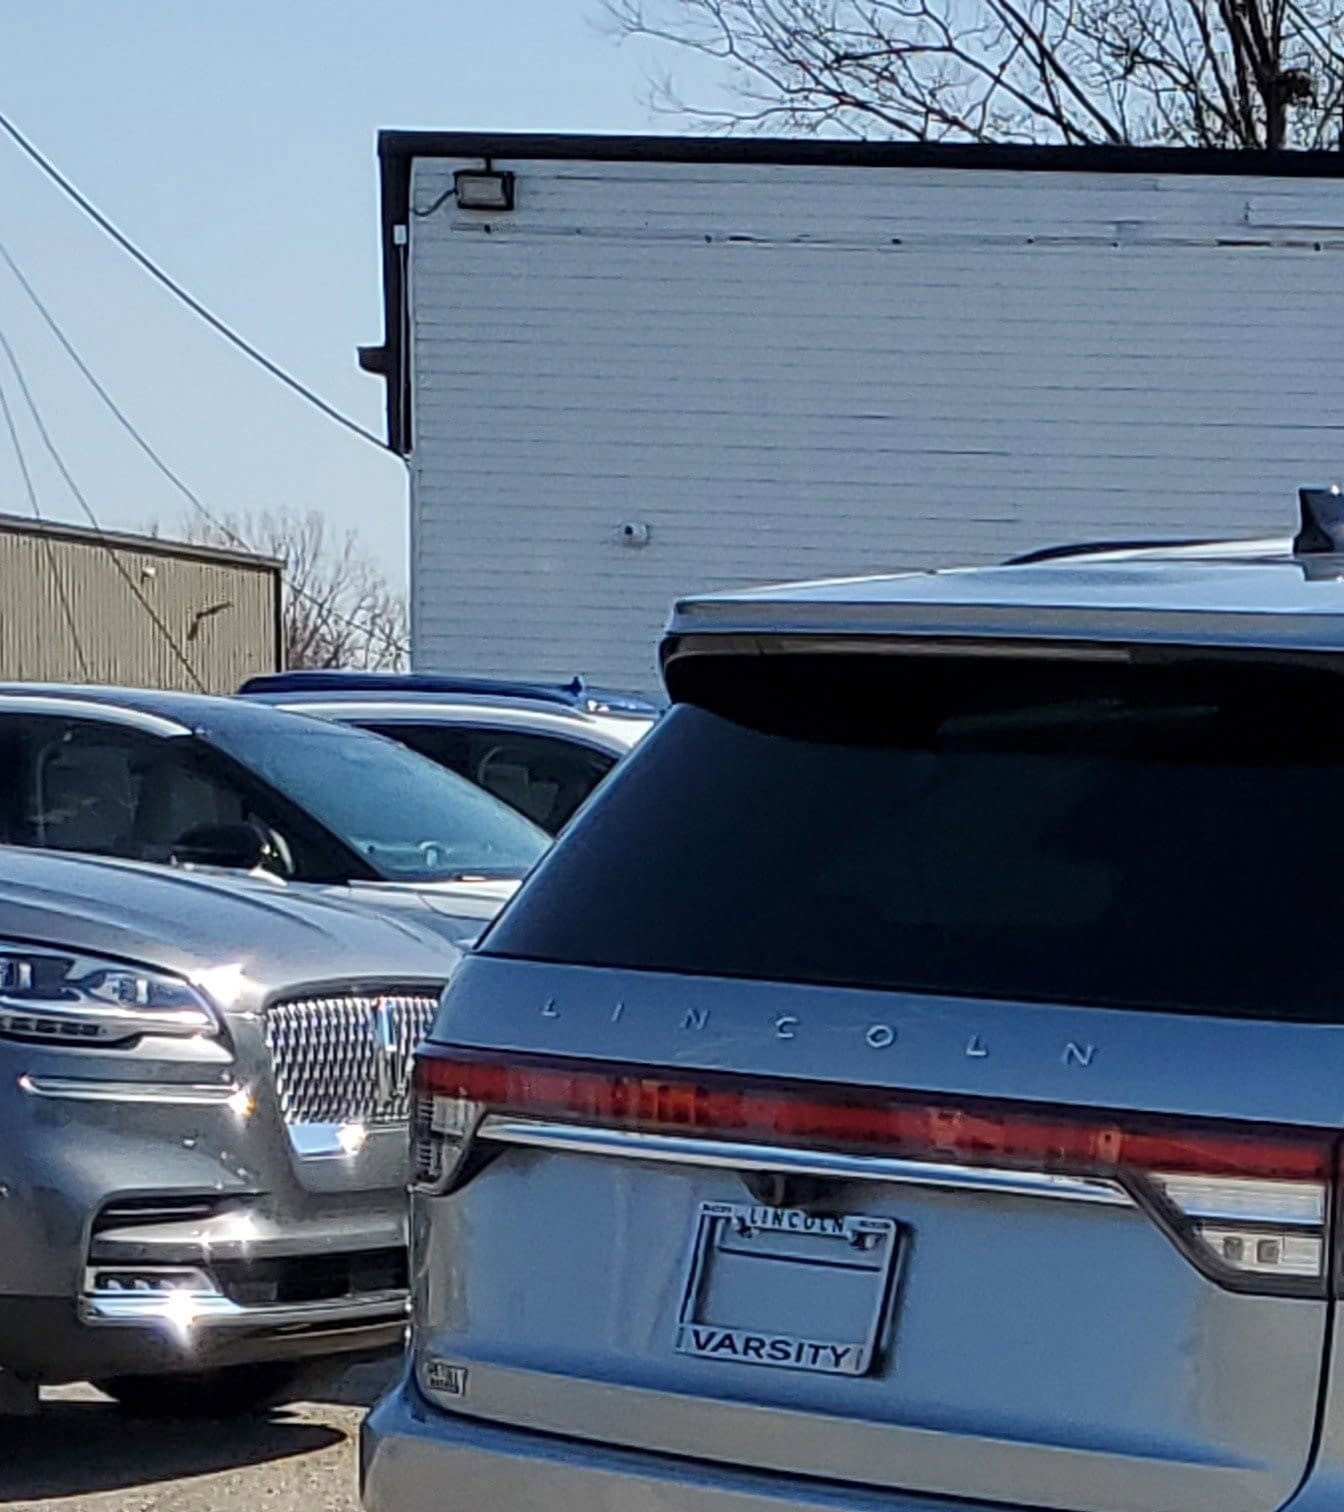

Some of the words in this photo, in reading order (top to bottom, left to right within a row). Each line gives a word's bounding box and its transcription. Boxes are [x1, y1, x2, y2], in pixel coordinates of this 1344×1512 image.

[540, 998, 1095, 1067] LINCOLN
[749, 1205, 844, 1234] LINCOLN
[692, 1329, 852, 1368] VARSITY
